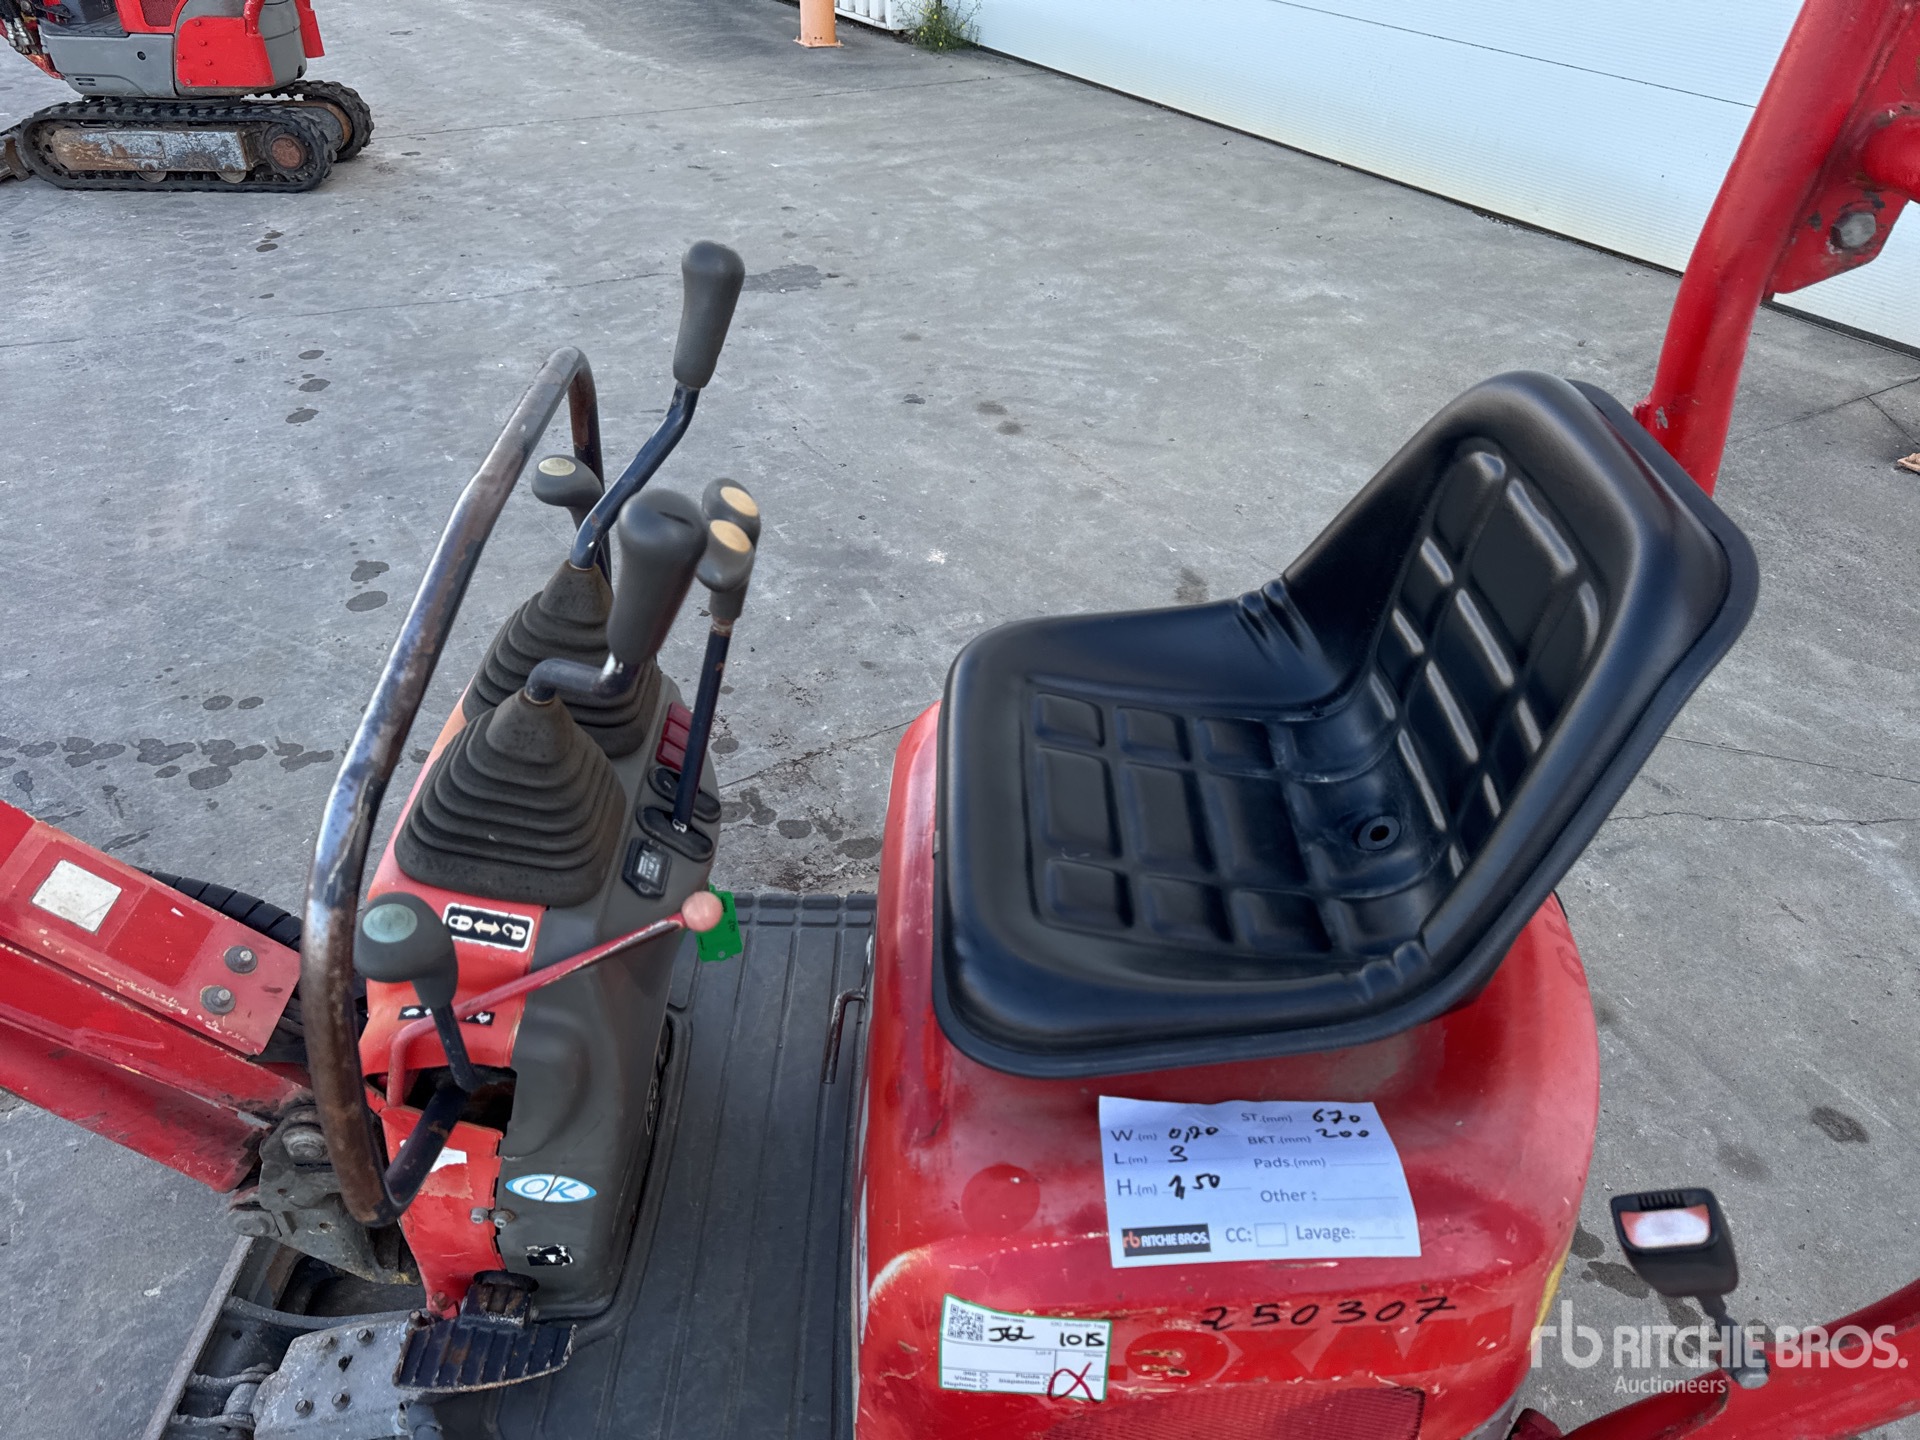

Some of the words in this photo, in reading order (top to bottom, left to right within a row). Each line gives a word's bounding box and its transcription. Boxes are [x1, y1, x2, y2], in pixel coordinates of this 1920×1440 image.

[1312, 1108, 1361, 1124] 670
[1315, 1128, 1370, 1139] 200
[1167, 1145, 1188, 1163] 3
[521, 1178, 580, 1199] OK
[1141, 1233, 1177, 1248] RITCHIE
[1225, 1226, 1252, 1244] CC:
[1296, 1225, 1356, 1242] Lavage:
[1200, 1296, 1457, 1332] 250307
